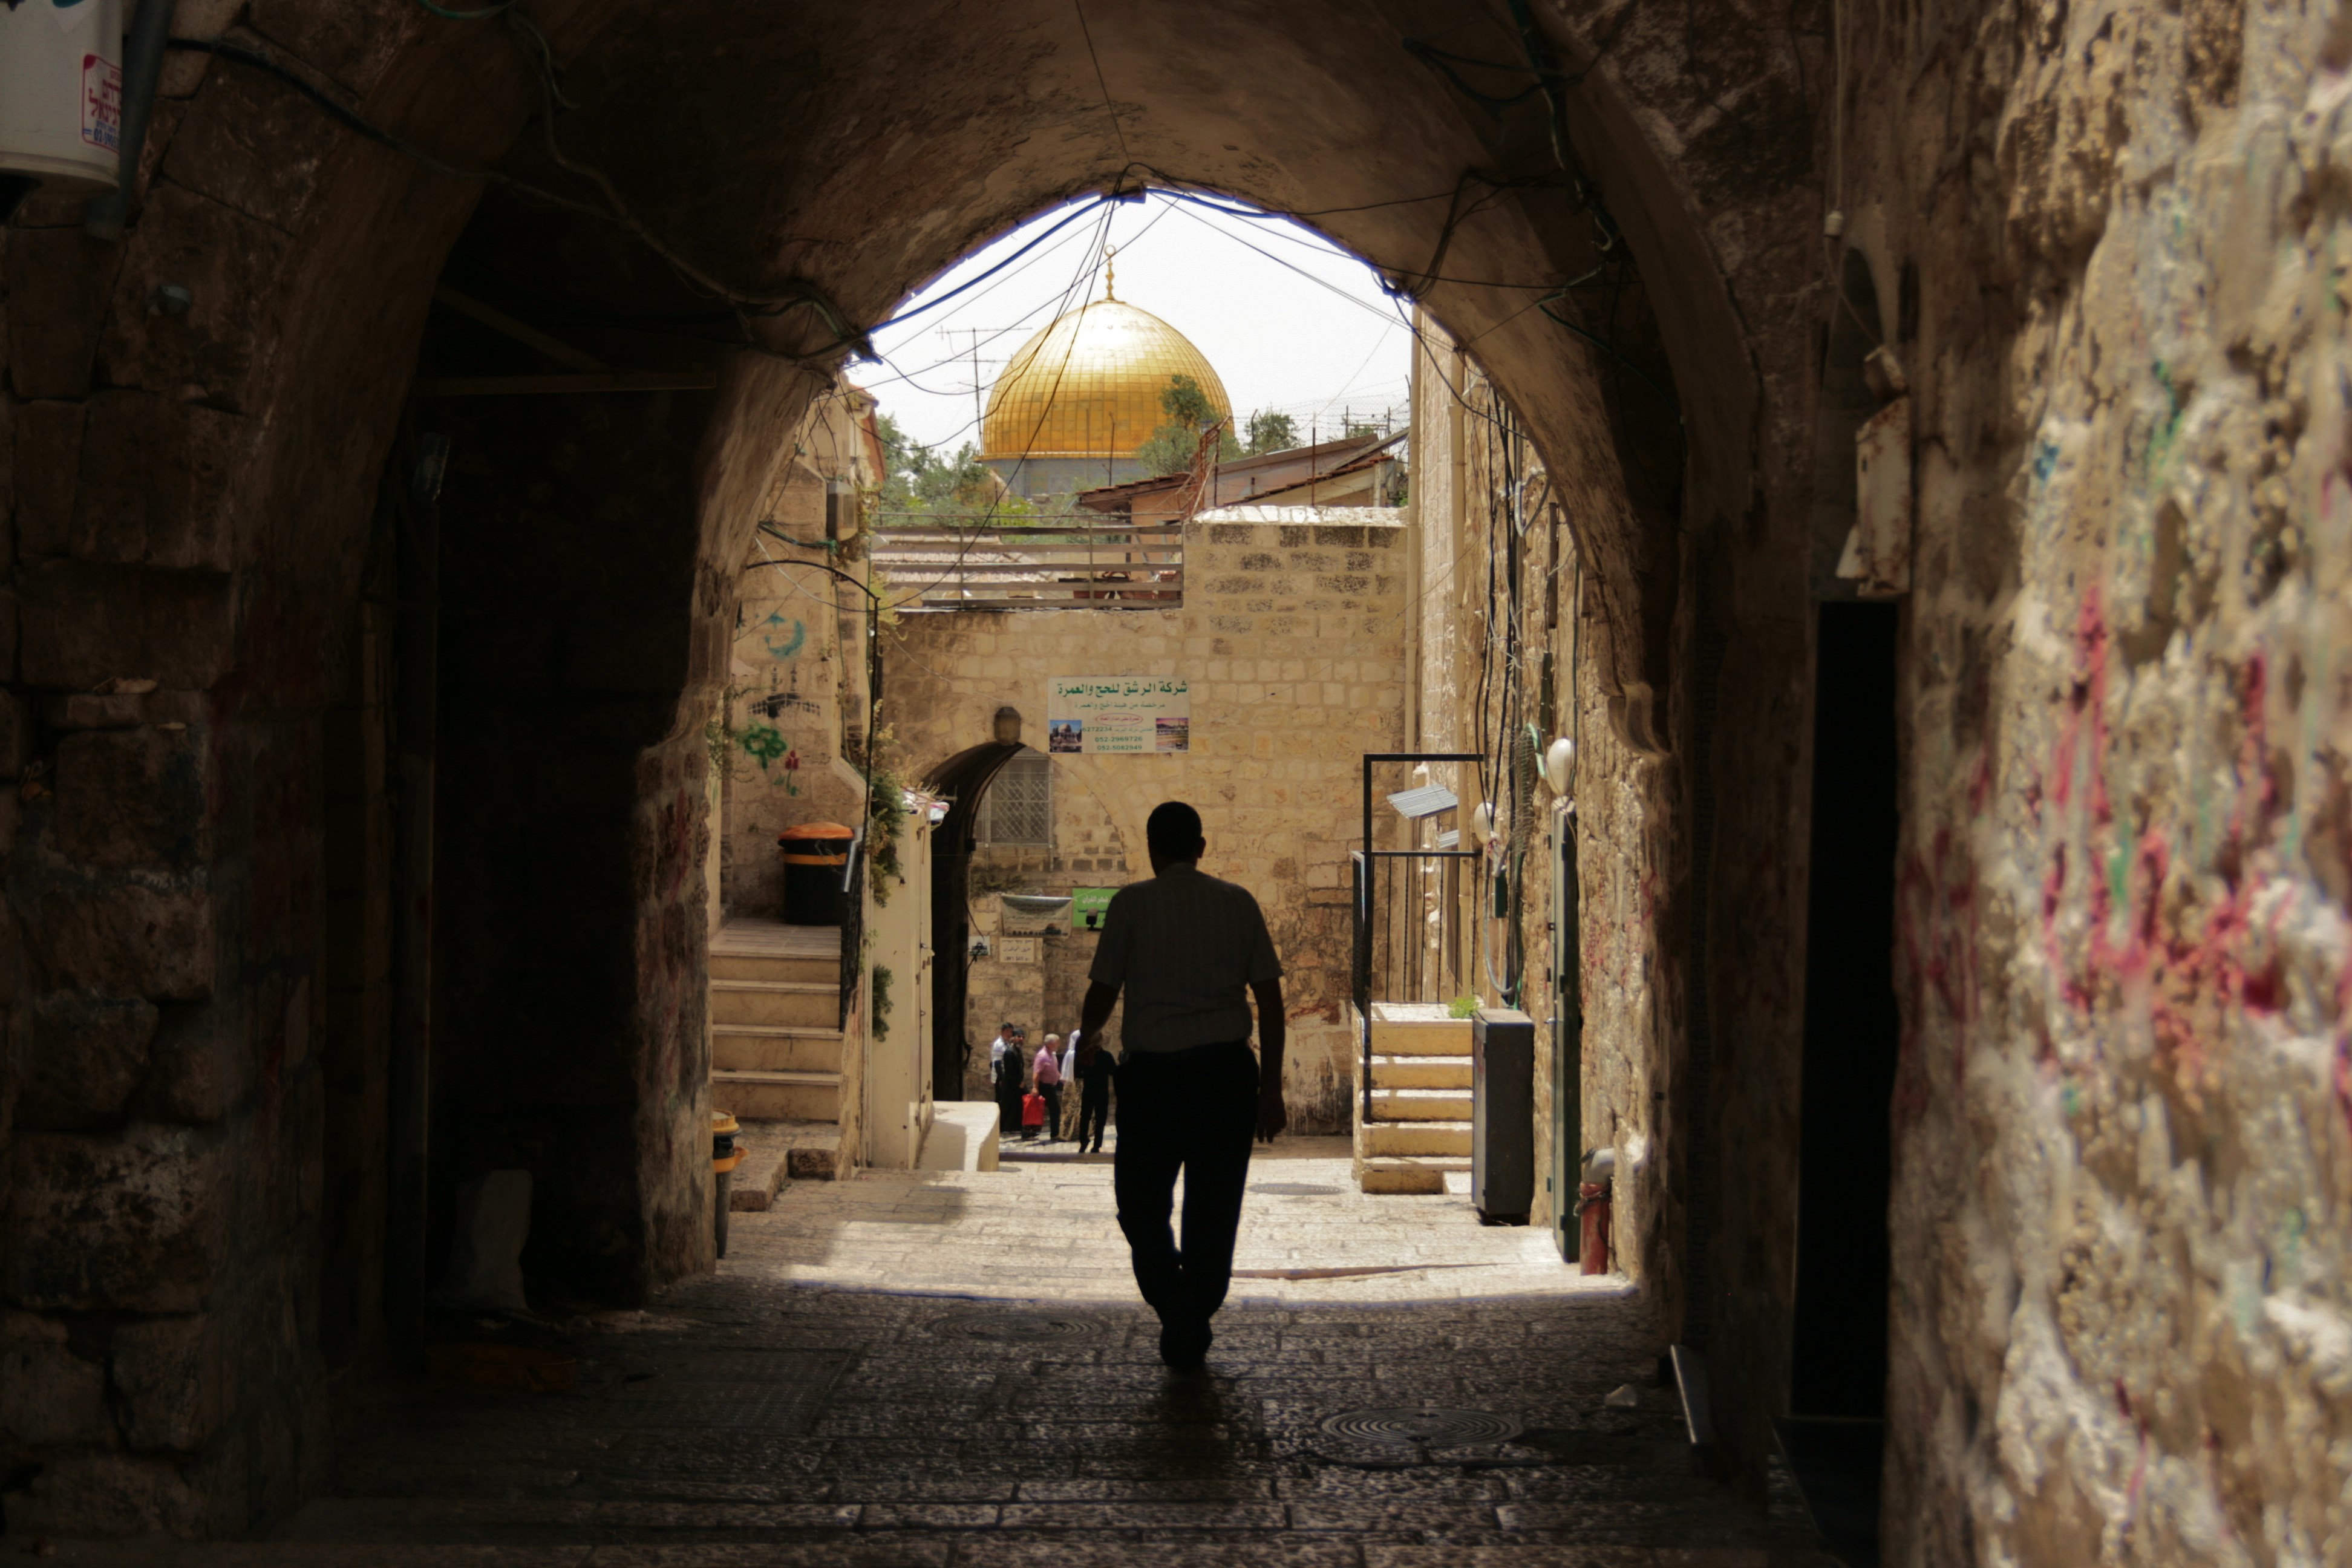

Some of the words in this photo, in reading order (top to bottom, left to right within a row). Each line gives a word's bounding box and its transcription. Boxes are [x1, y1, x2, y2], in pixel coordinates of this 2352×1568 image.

[1057, 683, 1093, 697] والعمرة
[1096, 682, 1120, 697] للحج
[1123, 681, 1156, 696] الرشق
[1158, 680, 1187, 696] شركة
